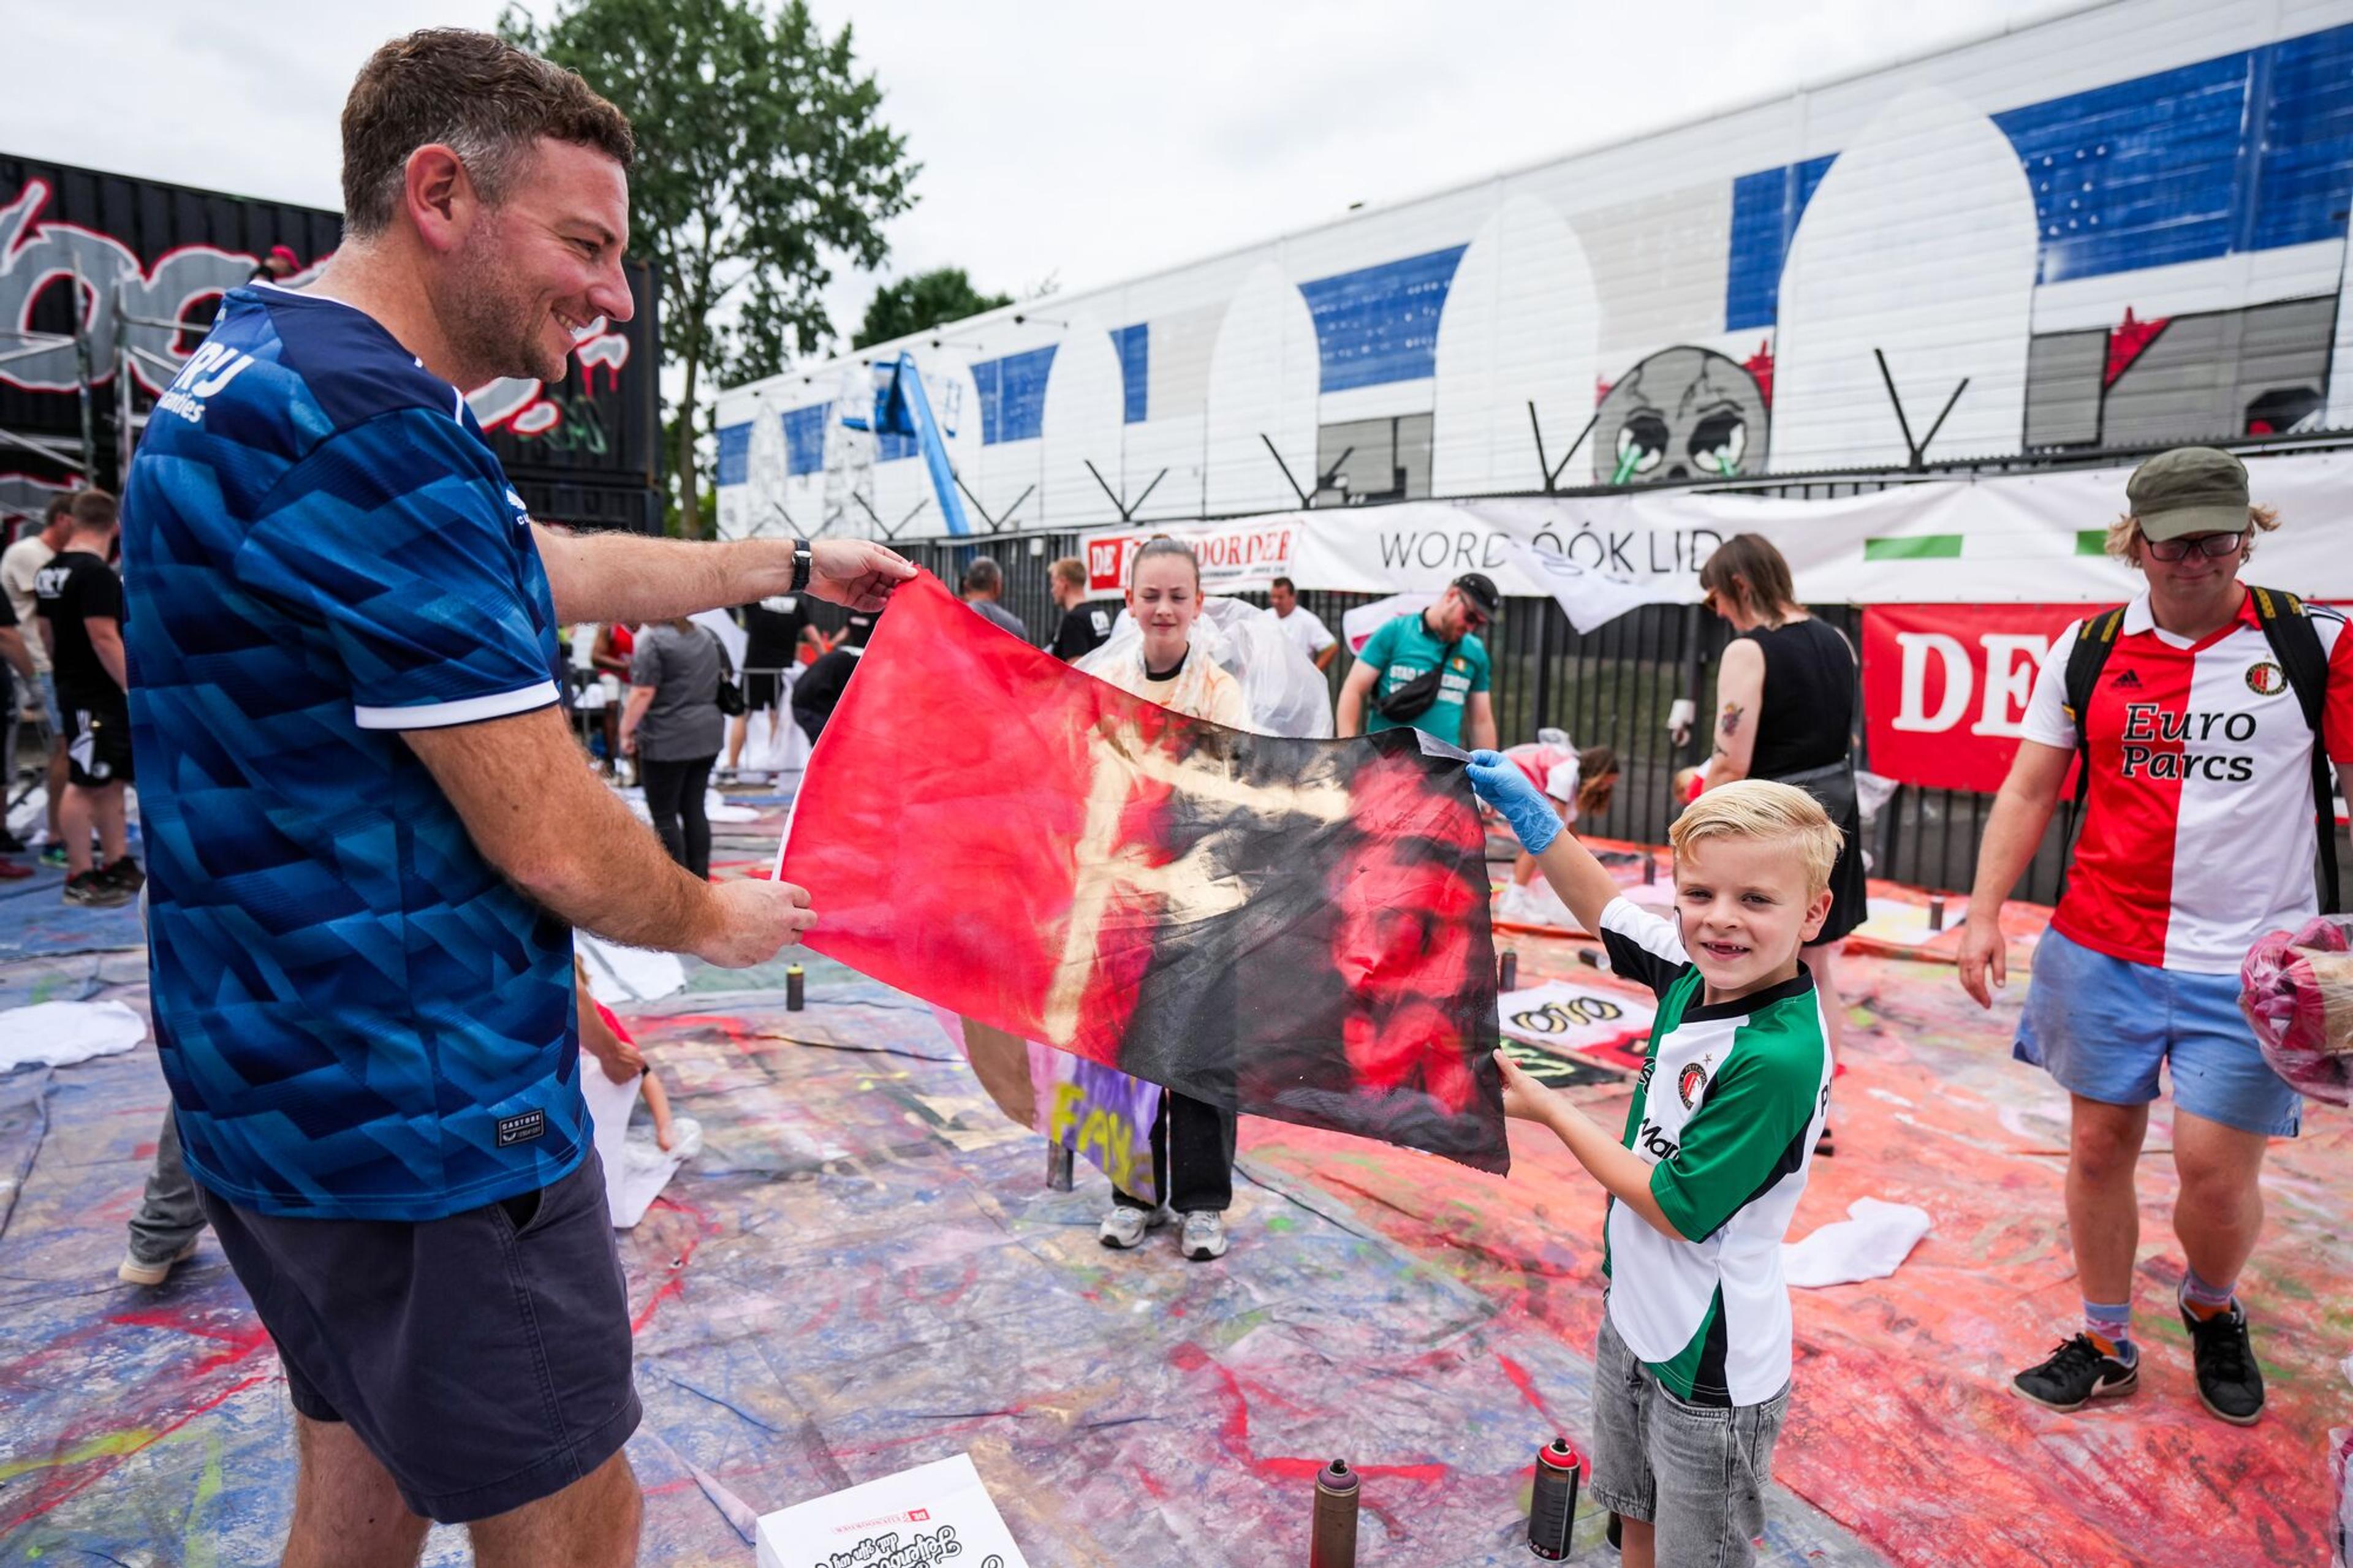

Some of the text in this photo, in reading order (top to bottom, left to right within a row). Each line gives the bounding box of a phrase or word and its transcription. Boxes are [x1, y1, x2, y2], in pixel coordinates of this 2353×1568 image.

[1091, 543, 1116, 577] DE
[1379, 531, 1511, 569] WORD
[1648, 529, 1724, 574] LID
[1893, 632, 2049, 739] DE
[2121, 703, 2257, 742] Euro
[2121, 745, 2254, 782] Parcs
